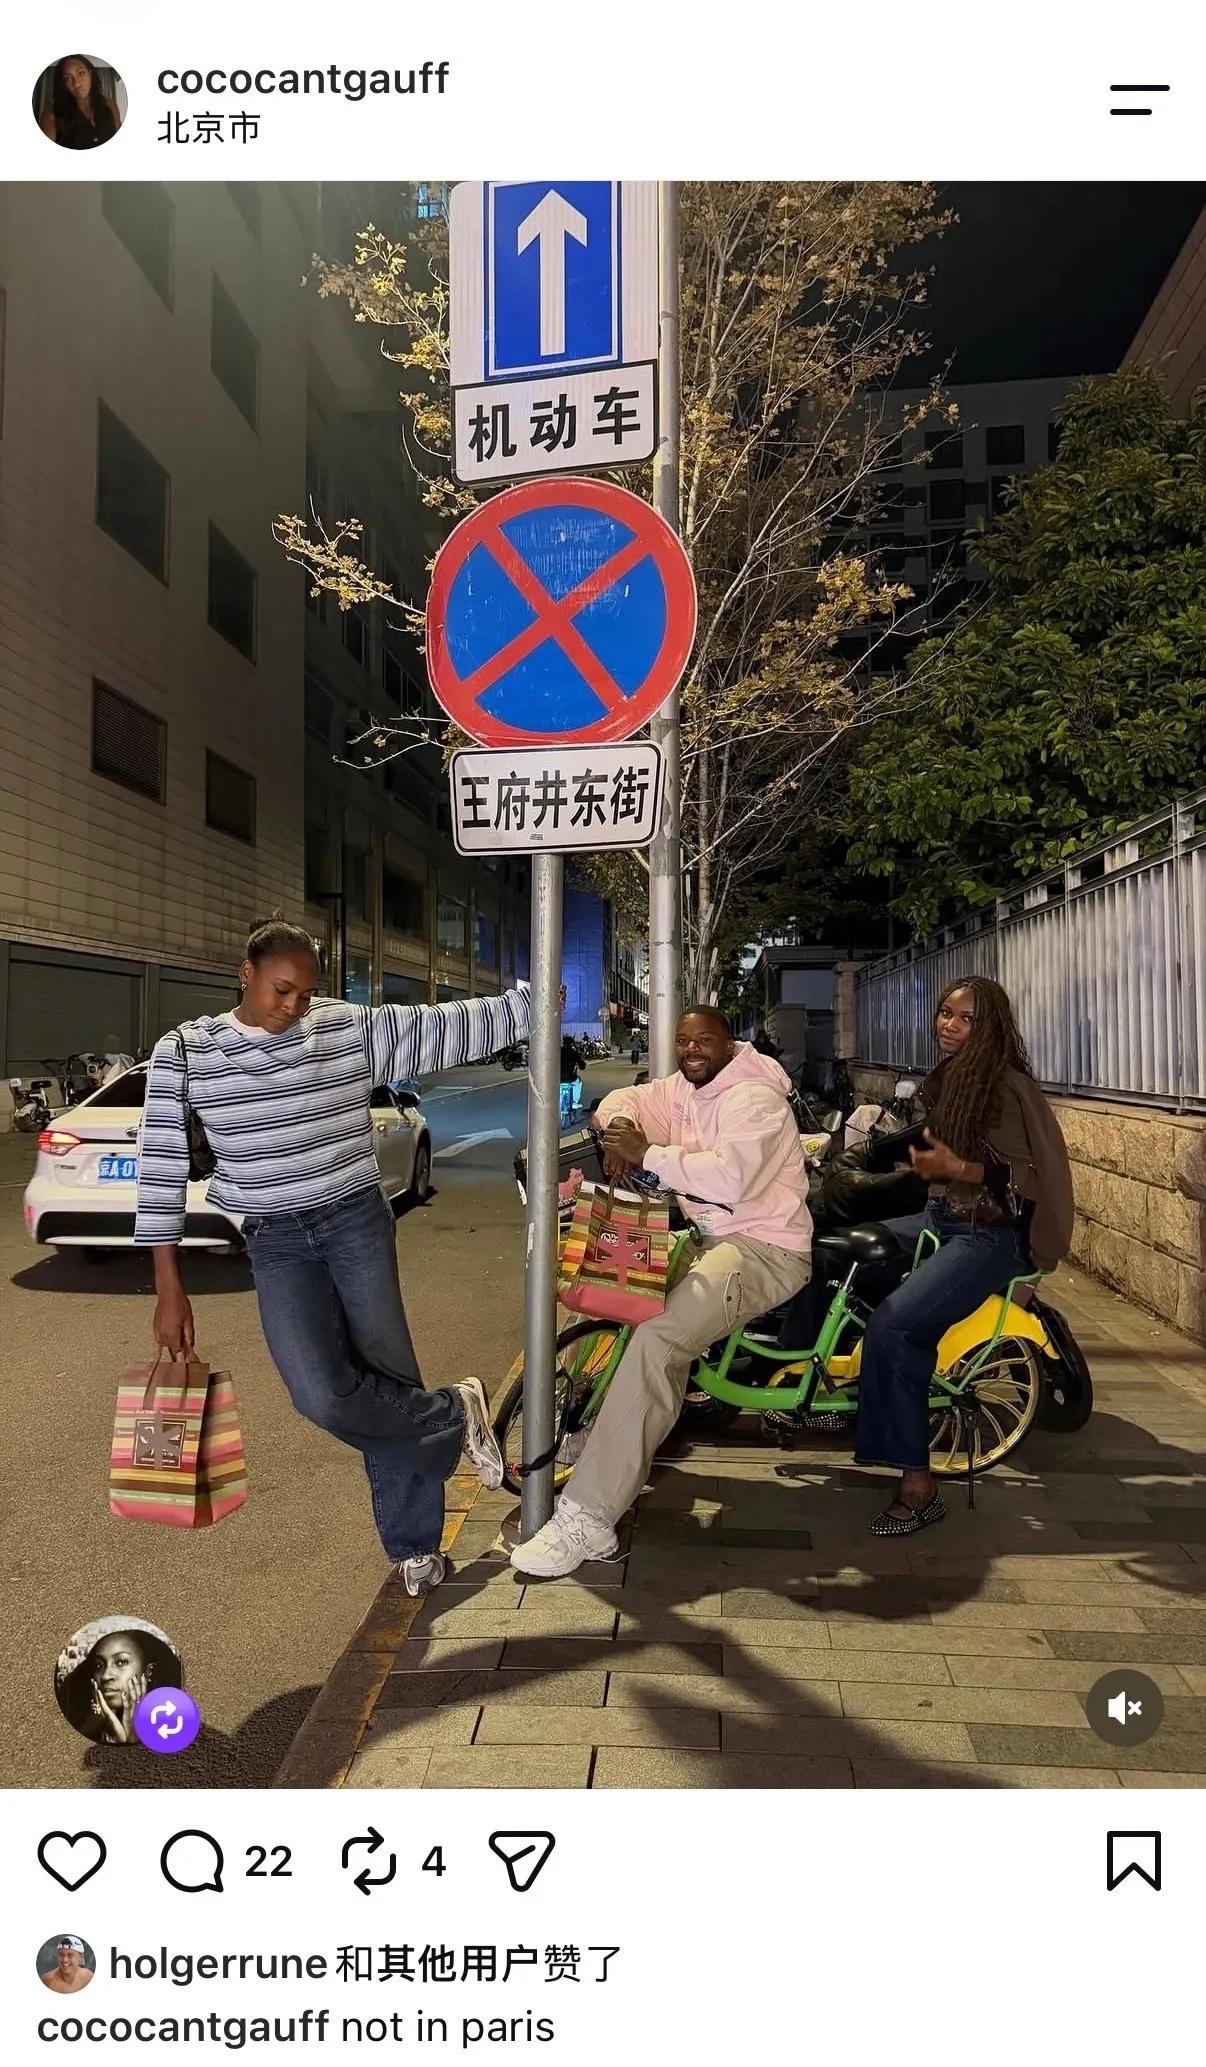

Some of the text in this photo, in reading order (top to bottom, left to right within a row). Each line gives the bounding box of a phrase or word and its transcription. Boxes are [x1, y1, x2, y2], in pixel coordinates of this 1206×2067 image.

[468, 386, 641, 464] 机动车
[460, 766, 650, 832] 王府井东街
